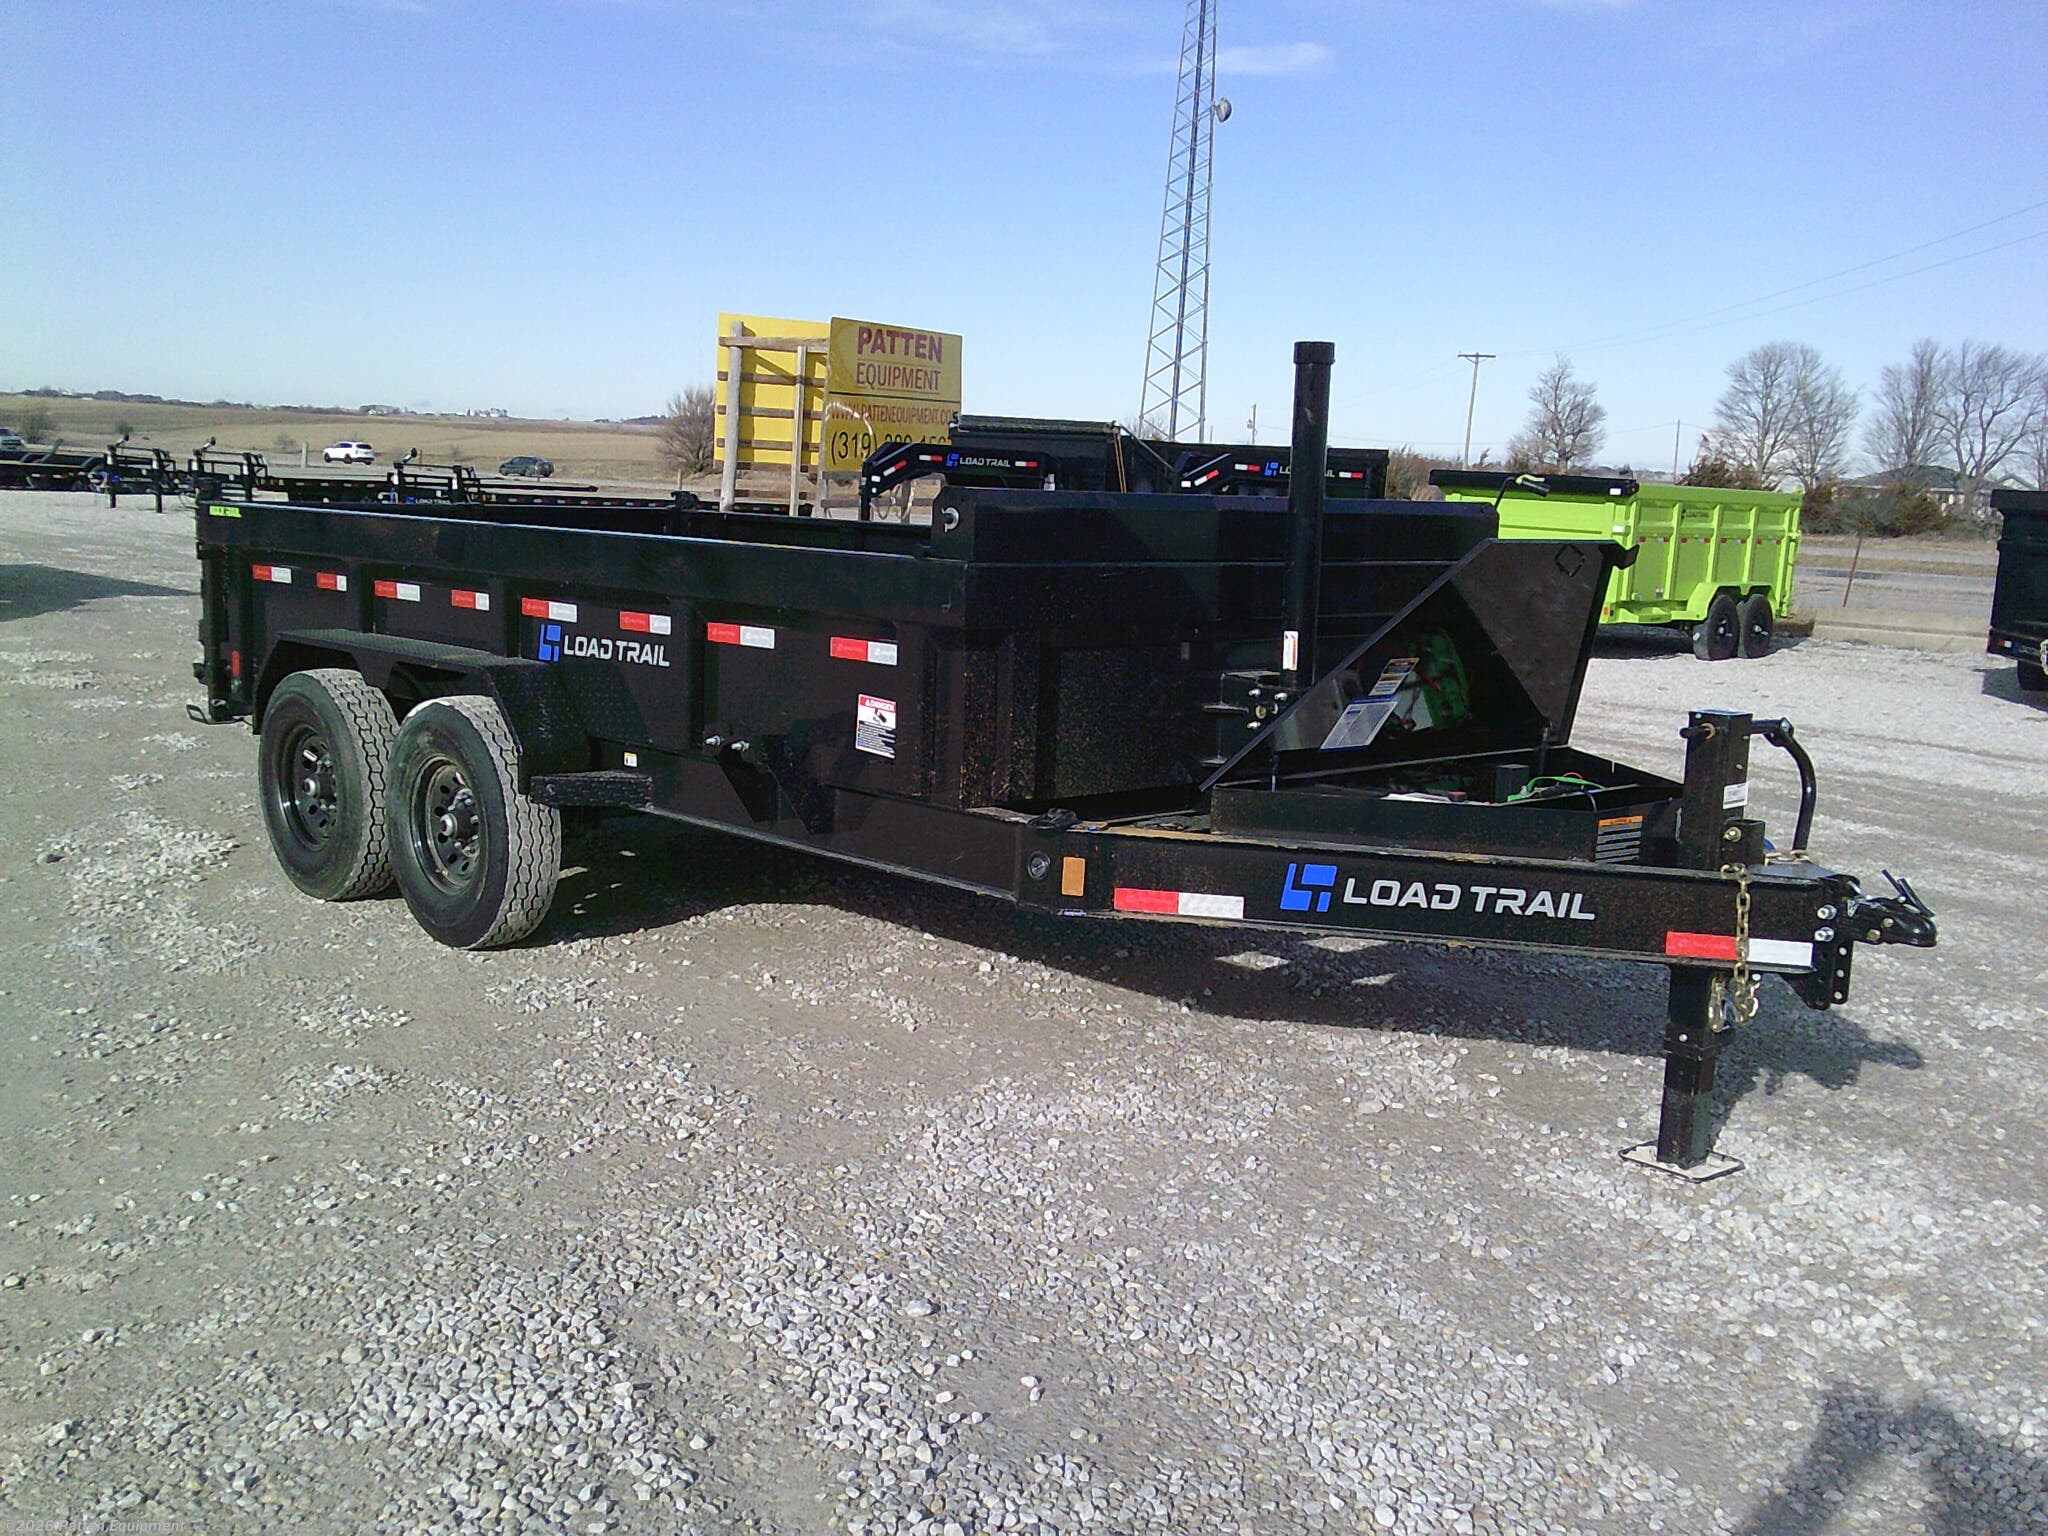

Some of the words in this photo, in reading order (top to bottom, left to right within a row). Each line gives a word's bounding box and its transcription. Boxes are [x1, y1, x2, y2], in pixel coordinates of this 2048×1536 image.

[857, 326, 943, 363] PATTEN
[856, 362, 941, 391] EQUIPMENT
[830, 402, 954, 425] WWW.PATTENEQUIPMENT.CO
[960, 457, 985, 466] LOAD
[986, 458, 1011, 467] TRAIL
[563, 635, 613, 660] LOAD
[615, 640, 671, 667] TRAIL
[1343, 877, 1462, 911] LOAD
[1470, 886, 1596, 921] TRAIL
